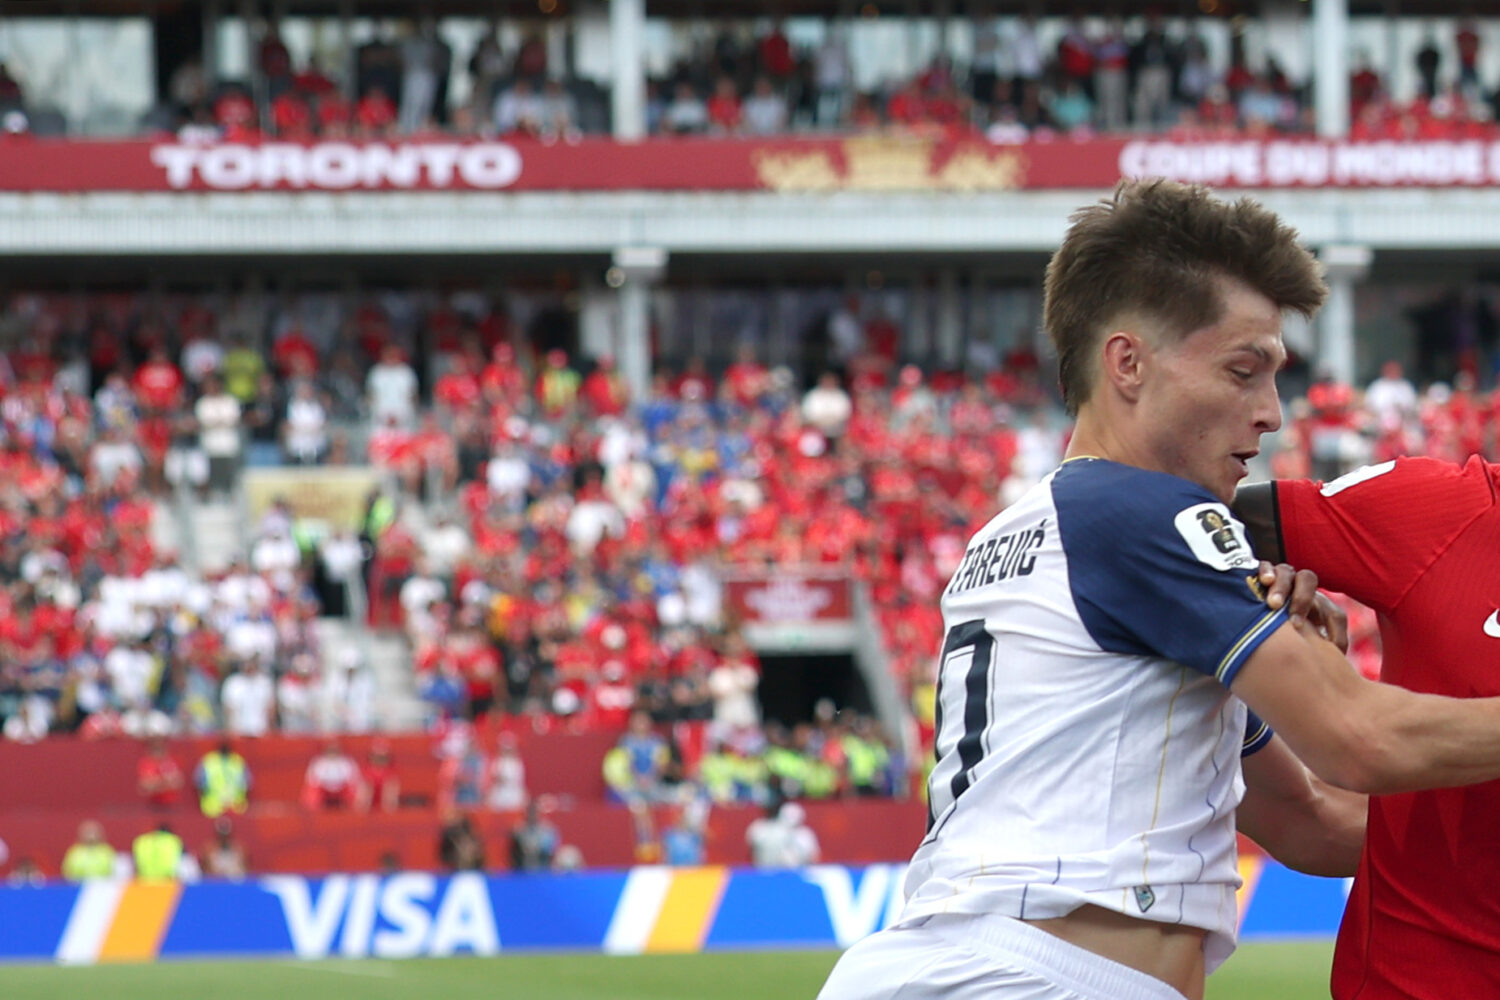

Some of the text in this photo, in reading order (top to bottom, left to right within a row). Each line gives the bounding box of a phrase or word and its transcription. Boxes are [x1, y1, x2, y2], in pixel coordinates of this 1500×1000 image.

[151, 143, 522, 189] TORONTO
[1266, 140, 1329, 184] DU
[1333, 140, 1484, 184] MONDE
[258, 870, 501, 959] VISA
